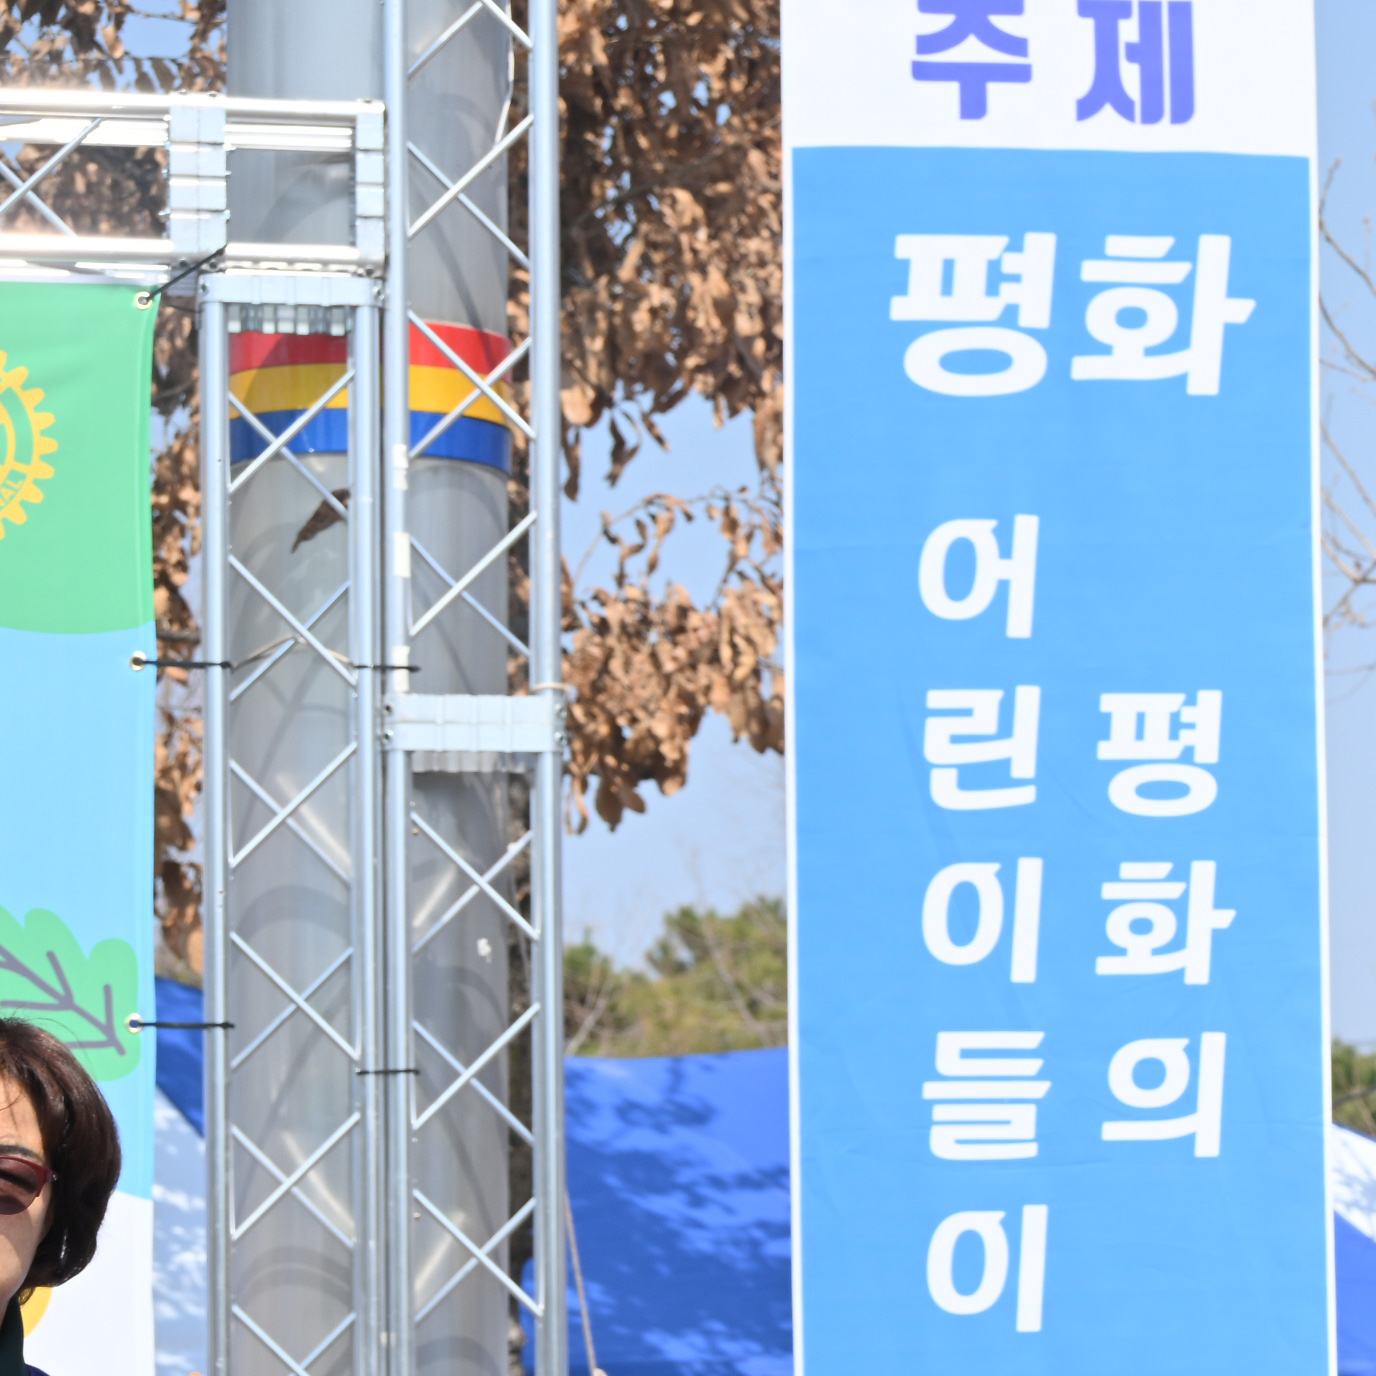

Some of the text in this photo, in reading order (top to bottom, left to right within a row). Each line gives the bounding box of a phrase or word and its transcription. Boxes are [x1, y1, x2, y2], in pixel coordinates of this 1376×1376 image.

[911, 0, 1196, 125] 주제
[889, 231, 1257, 397] 평화
[918, 513, 1052, 1333] 어린이들이
[1095, 689, 1237, 1158] 평화의
